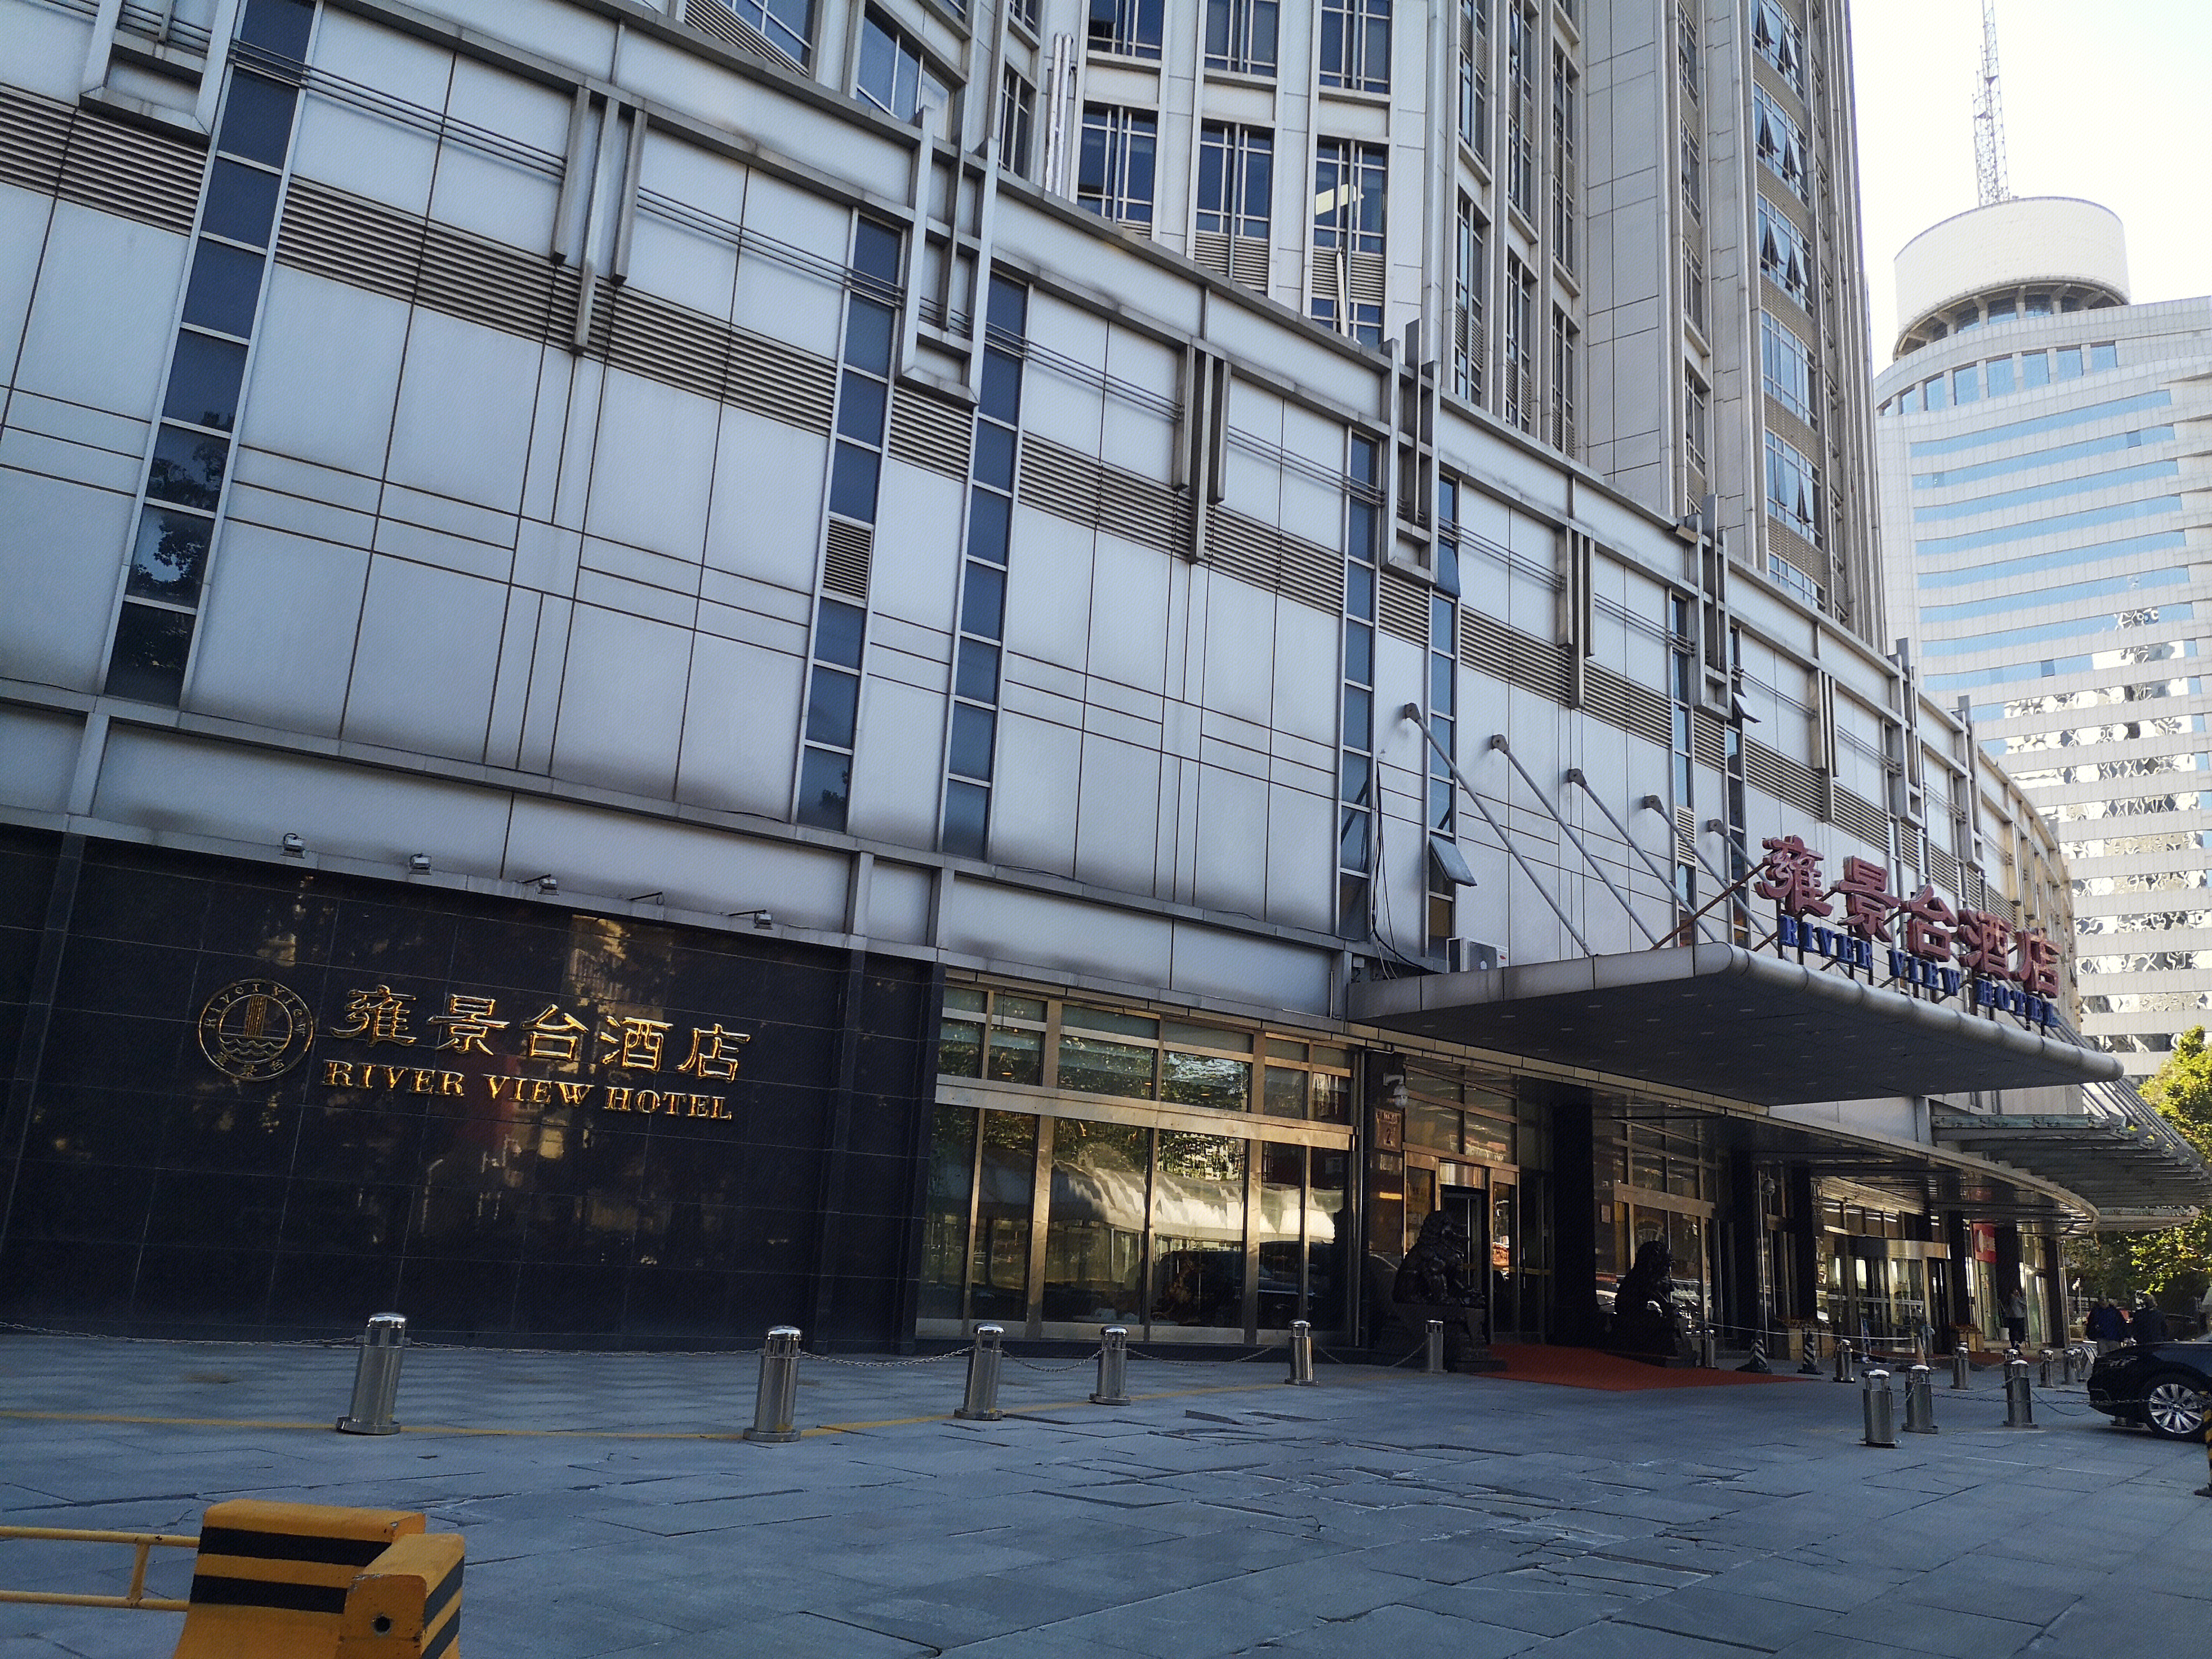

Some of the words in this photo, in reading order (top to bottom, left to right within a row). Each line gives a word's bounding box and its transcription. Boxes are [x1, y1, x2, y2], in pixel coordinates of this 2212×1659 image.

[1754, 835, 2061, 998] 雍景台酒店
[1778, 915, 1873, 970] RIVER
[1887, 949, 1961, 996] VIEW
[1973, 977, 2059, 1027] HOTEL
[329, 984, 751, 1081] 雍景台酒店
[321, 1059, 465, 1097] RIVER
[481, 1073, 595, 1107] VIEW
[603, 1085, 732, 1120] HOTEL
